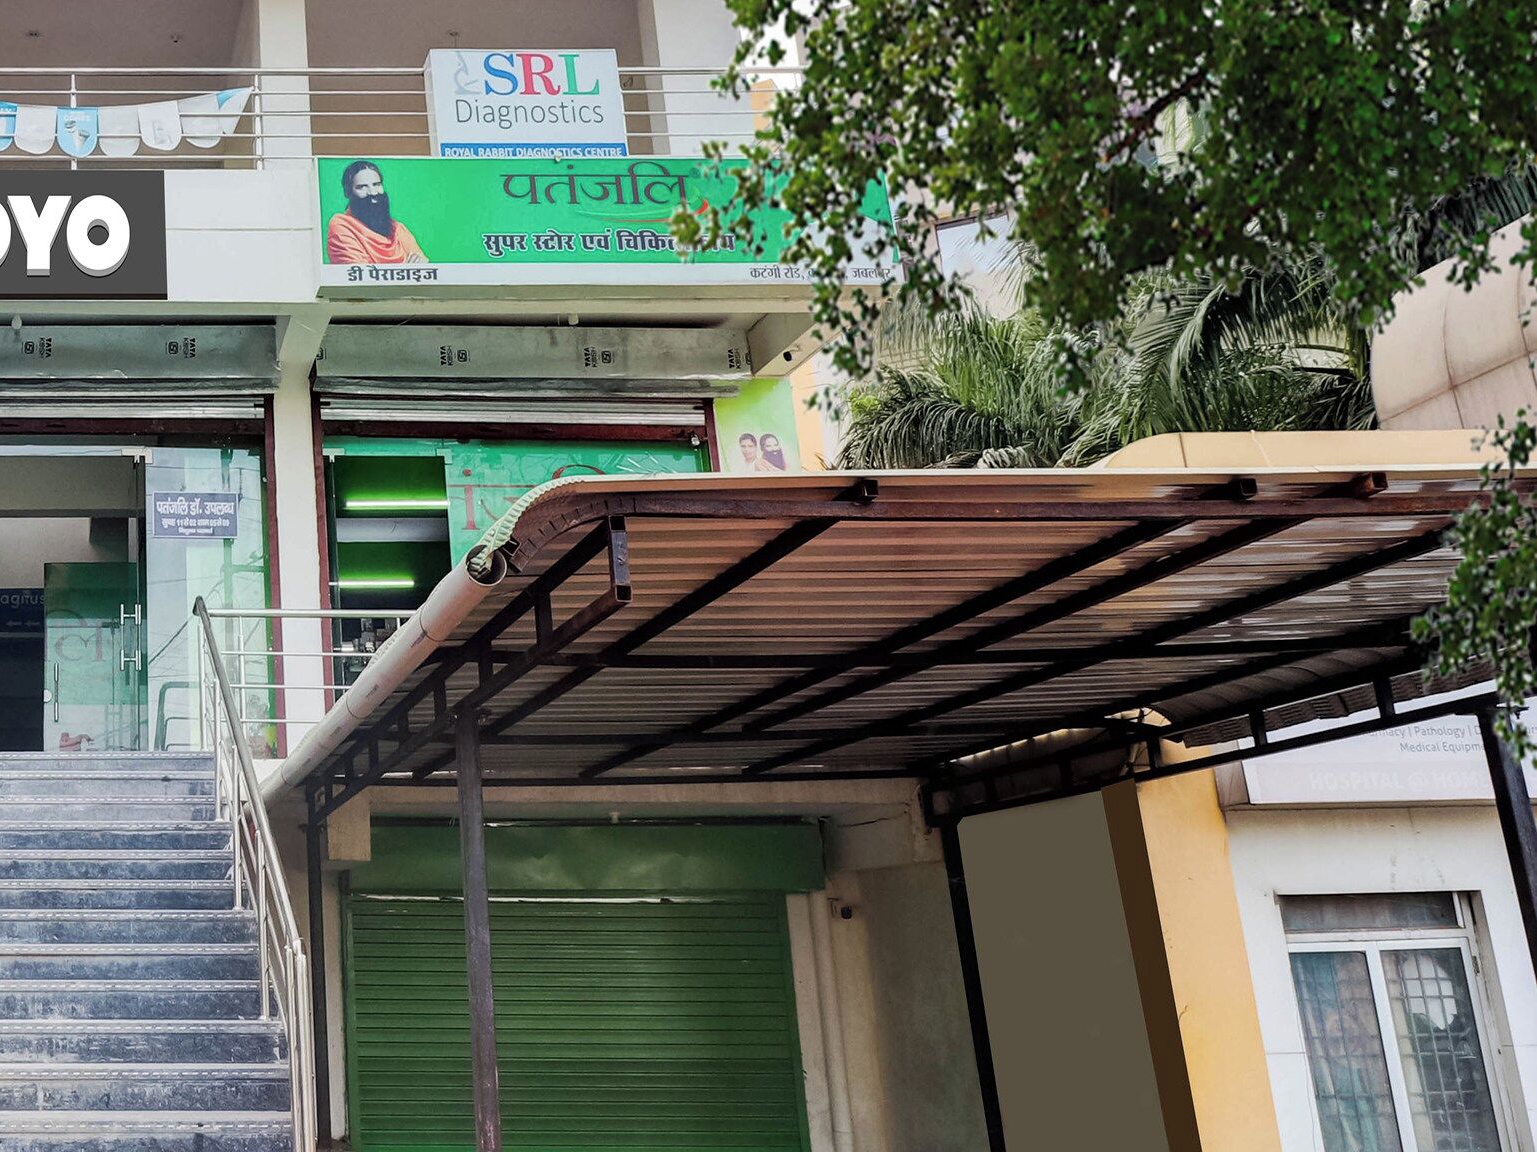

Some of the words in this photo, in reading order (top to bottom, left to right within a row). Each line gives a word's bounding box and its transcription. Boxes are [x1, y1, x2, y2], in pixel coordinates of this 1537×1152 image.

[483, 52, 601, 96] SRL
[455, 98, 605, 130] Diagnostics
[444, 147, 475, 157] ROYAL
[479, 147, 513, 157] RABBIT
[517, 147, 582, 157] DIAGNOSTICS
[584, 147, 624, 157] CENTRE
[499, 161, 688, 205] पतंजलि
[483, 232, 527, 257] सुपर
[533, 230, 575, 251] स्टोर
[581, 229, 611, 251] एवं
[347, 265, 364, 282] डी
[366, 264, 439, 282] पैराडाइज
